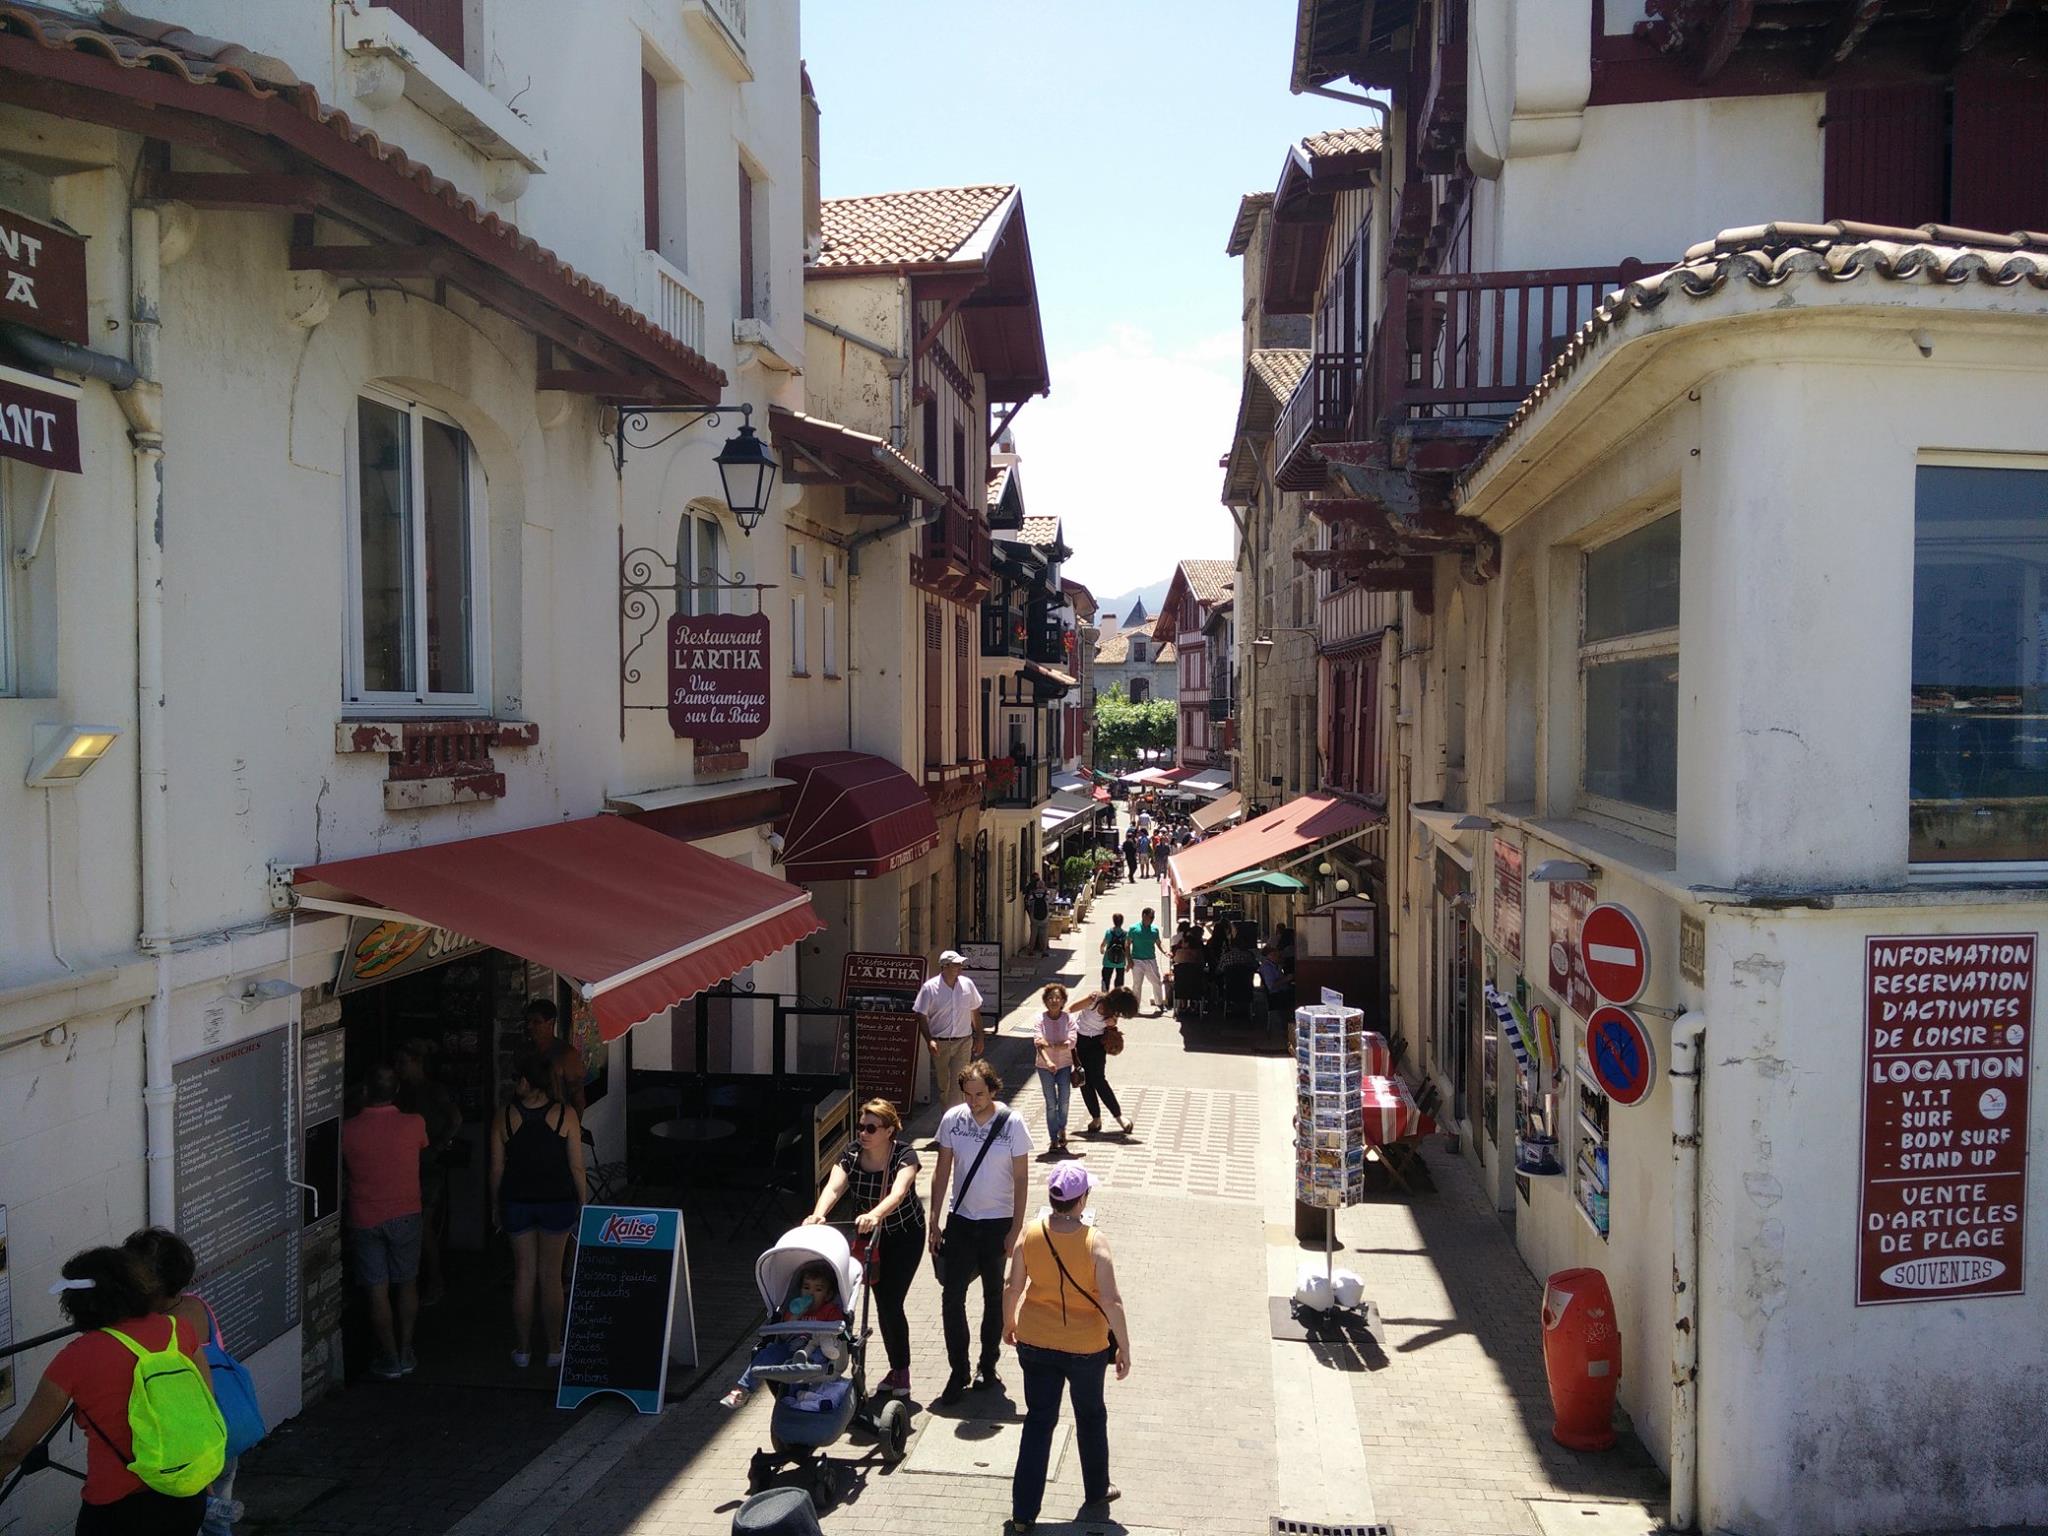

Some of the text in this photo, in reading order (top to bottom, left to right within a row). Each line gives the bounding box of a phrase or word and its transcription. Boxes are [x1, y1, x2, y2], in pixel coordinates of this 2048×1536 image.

[675, 625, 762, 645] Restaurant
[689, 674, 717, 691] Vue
[674, 687, 766, 710] Panoramique
[685, 706, 760, 723] sur la Baie
[857, 957, 917, 969] Restaurant
[1874, 944, 2031, 968] INFORMATION
[848, 965, 920, 980] L'ARTHA
[1874, 971, 2030, 994] RESERVATION
[1882, 997, 2019, 1022] D'ACTIVITES
[1874, 1025, 1987, 1048] DE LOISIR
[1873, 1057, 2023, 1083] LOCATION
[1902, 1089, 1951, 1107] V.T.T
[1901, 1110, 1953, 1128] SURF
[1901, 1128, 2011, 1149] BODY SURF
[1900, 1149, 1997, 1170] STAND UP
[1902, 1184, 1987, 1206] VENTE
[604, 1213, 656, 1244] Kalise
[1868, 1204, 2018, 1231] D'ARTICLES
[1880, 1228, 2005, 1253] DE PLAGE
[1894, 1260, 1993, 1285] SOUVENIRS
